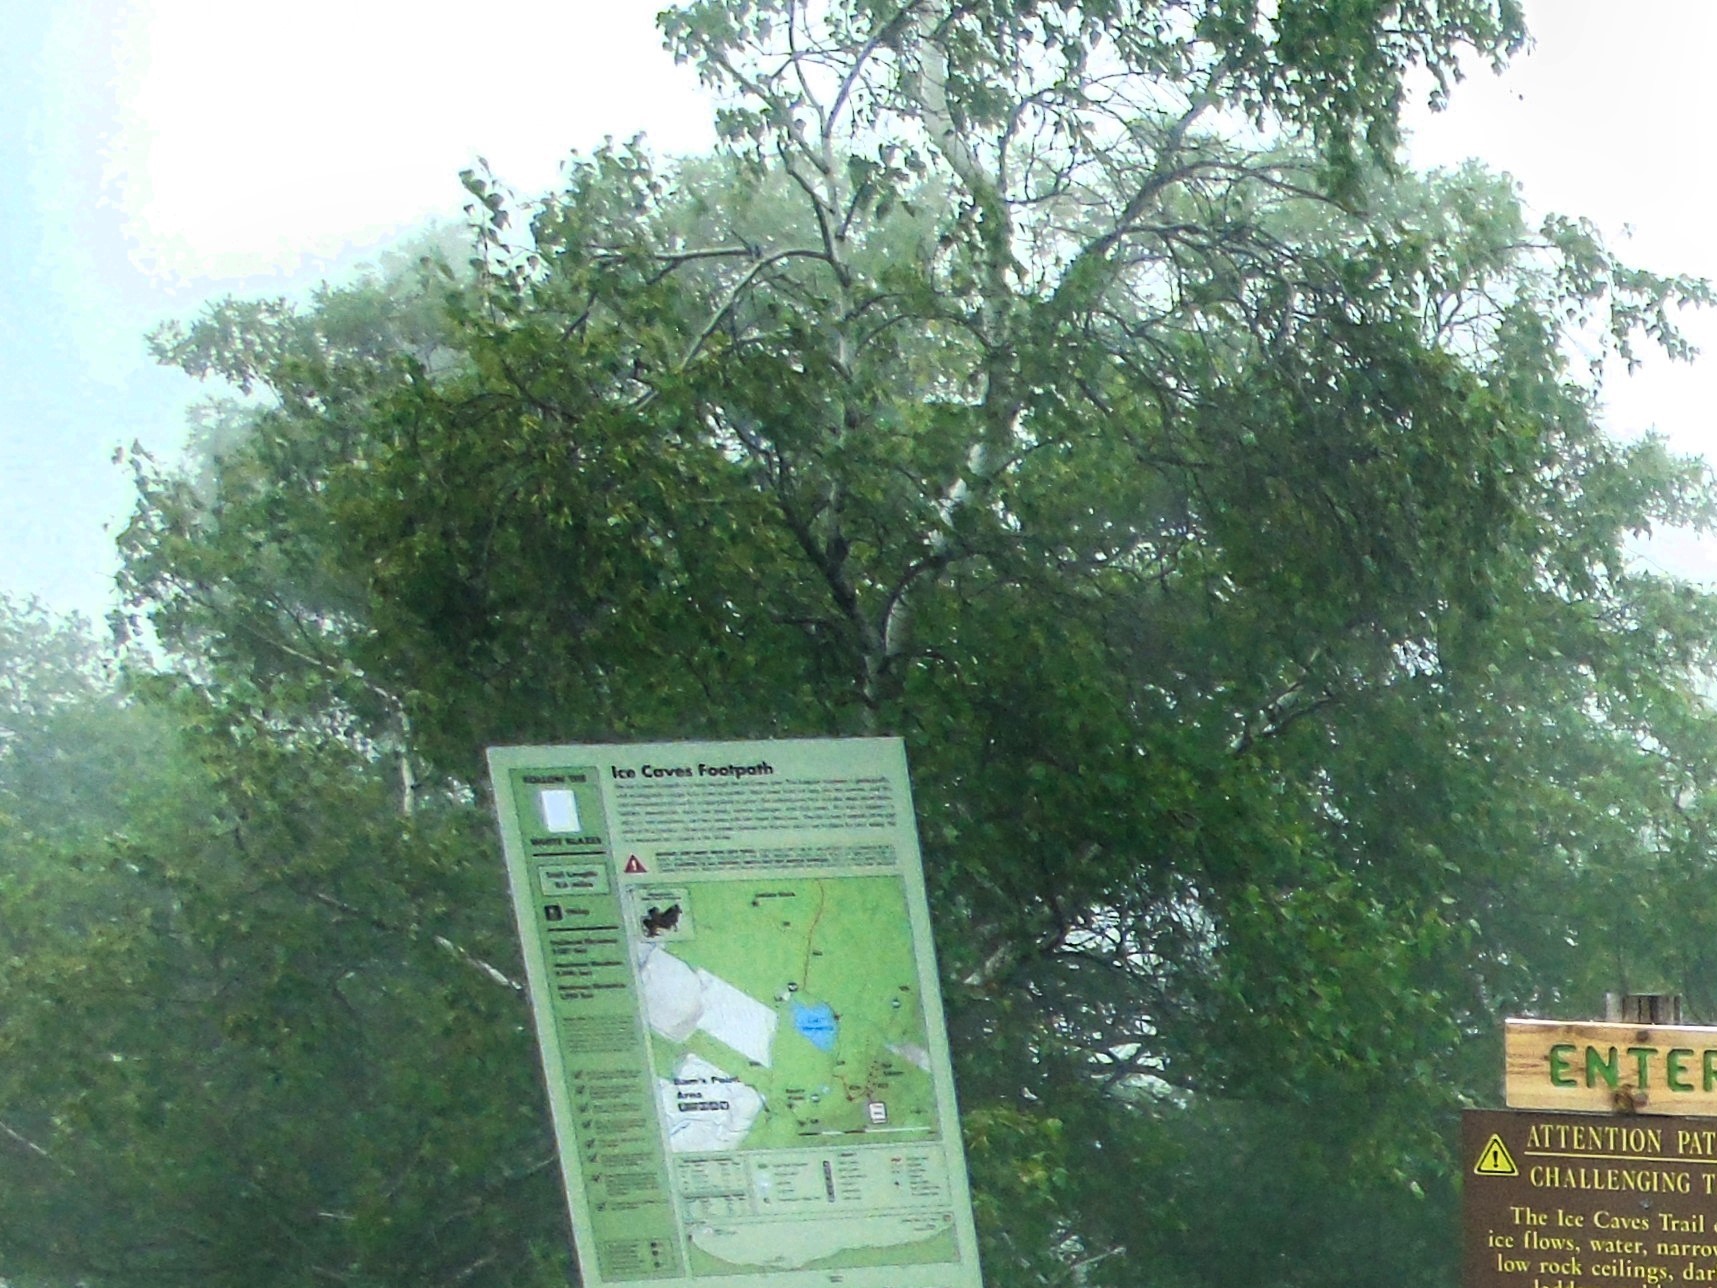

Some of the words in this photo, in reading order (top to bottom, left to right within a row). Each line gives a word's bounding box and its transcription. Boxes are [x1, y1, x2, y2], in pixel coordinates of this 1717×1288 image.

[612, 765, 635, 780] Ice
[642, 765, 693, 779] Caves
[699, 762, 774, 780] Footpath
[1526, 1124, 1662, 1153] ATTENTION
[1530, 1165, 1691, 1195] CHALLENGING
[1509, 1206, 1548, 1227] The
[1557, 1209, 1584, 1228] Ice
[1593, 1210, 1650, 1231] Caves
[1658, 1212, 1705, 1233] Trail
[1488, 1230, 1514, 1249] ice
[1524, 1231, 1581, 1253] flows,
[1590, 1237, 1648, 1257] water,
[1497, 1253, 1531, 1272] low
[1539, 1257, 1583, 1276] rock
[1591, 1259, 1675, 1284] ceilings,
